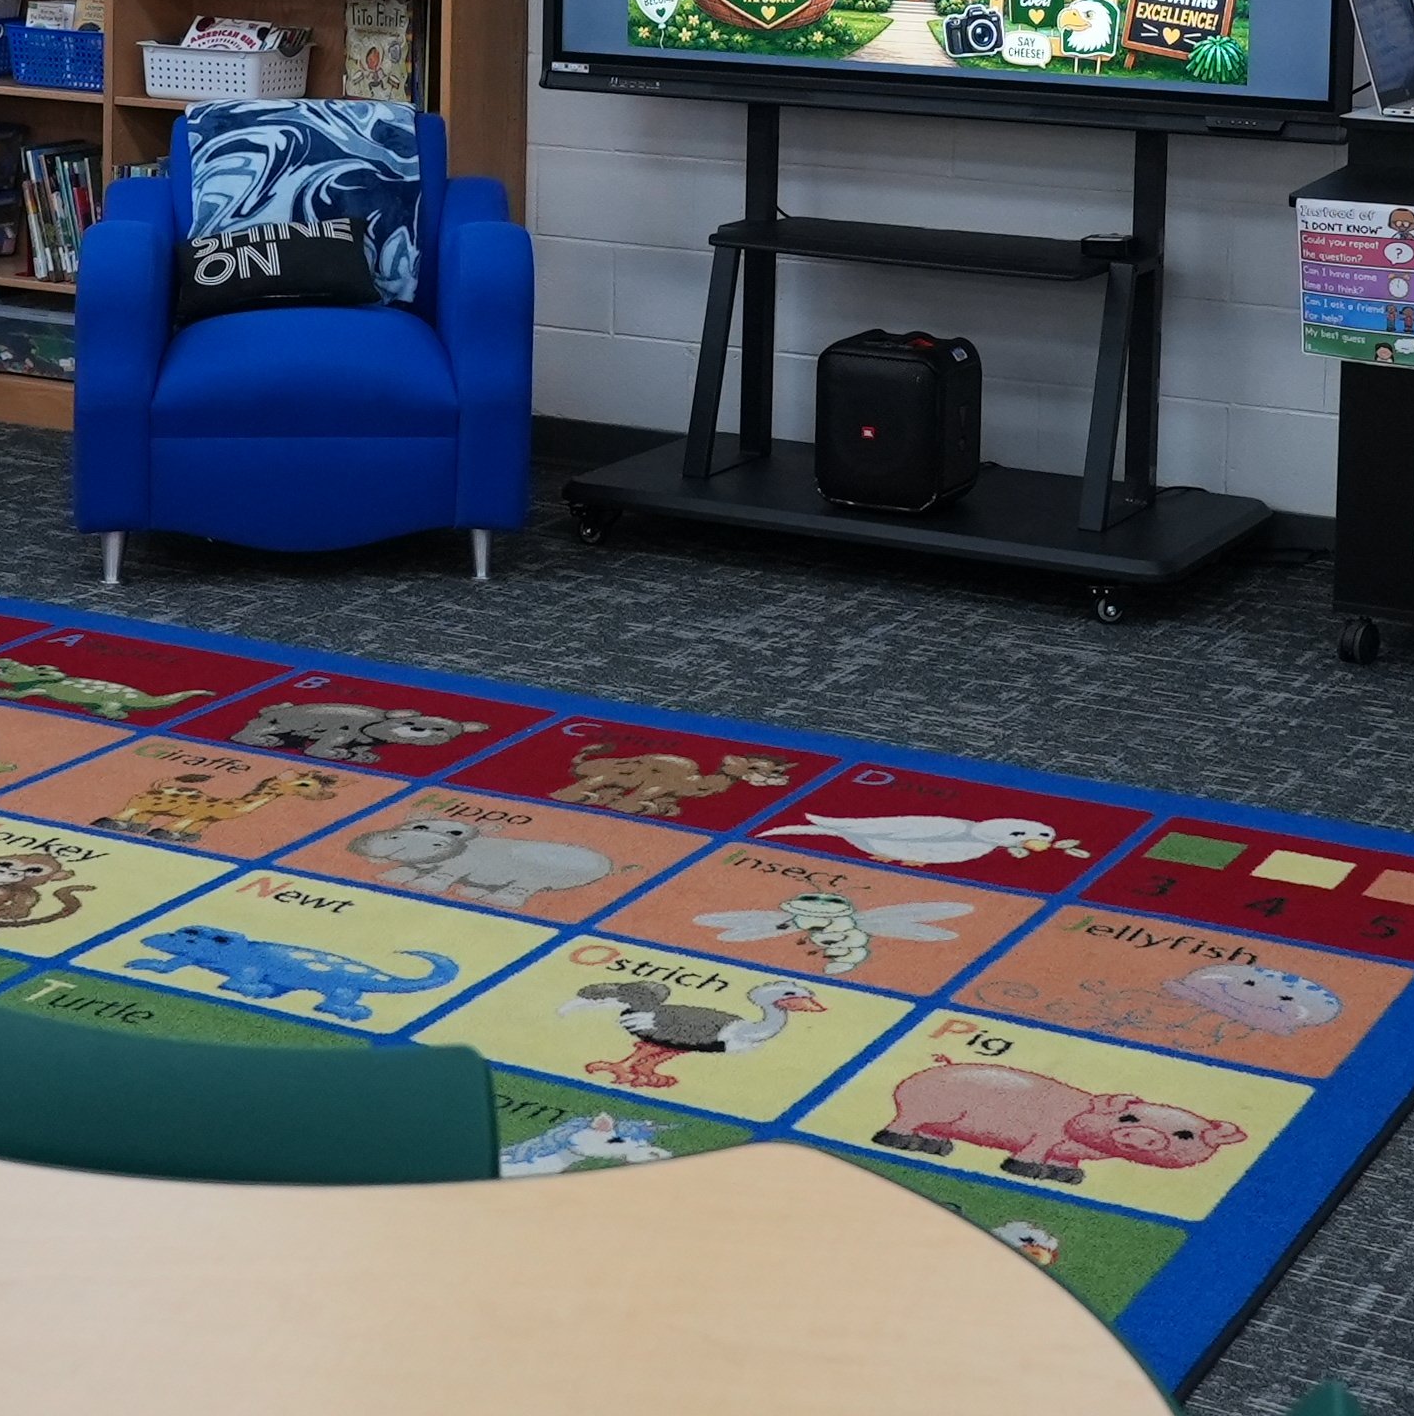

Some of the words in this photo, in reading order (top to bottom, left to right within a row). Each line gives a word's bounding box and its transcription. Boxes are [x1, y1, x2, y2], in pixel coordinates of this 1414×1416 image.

[1136, 2, 1219, 31] EXCELLENCE!
[190, 30, 240, 45] AMERICAN
[1018, 36, 1036, 47] SAY
[1008, 47, 1045, 60] CHEESE!
[1300, 205, 1354, 221] Instead
[1359, 211, 1376, 221] of
[1312, 222, 1343, 232] DON'T
[191, 218, 354, 258] SHINE
[1302, 235, 1325, 245] Could
[1329, 238, 1346, 247] you
[1349, 241, 1379, 250] repeat
[194, 242, 281, 285] ON
[1303, 249, 1315, 258] the
[1319, 252, 1363, 262] question?
[1303, 266, 1319, 276] Can
[1329, 269, 1350, 280] have
[1354, 272, 1377, 281] some
[1303, 280, 1321, 290] time
[1325, 283, 1334, 292] to
[1338, 285, 1364, 294] think?
[1304, 296, 1320, 306] Can
[1331, 301, 1345, 309] ask
[1357, 303, 1385, 313] friend
[1305, 312, 1318, 320] for
[1322, 314, 1343, 324] help?
[1305, 327, 1318, 337] My
[1321, 329, 1339, 340] best
[1342, 334, 1365, 344] guess
[132, 739, 253, 780] Giraffe
[410, 791, 534, 833] Hippo
[718, 844, 849, 891] Insect
[235, 873, 356, 920] Newt
[1245, 897, 1289, 917] 4
[1359, 916, 1404, 938] 5
[1056, 916, 1260, 970] Jellyfish
[567, 942, 732, 998] Ostrich
[21, 978, 156, 1028] Turtle
[929, 1017, 1014, 1061] Pig
